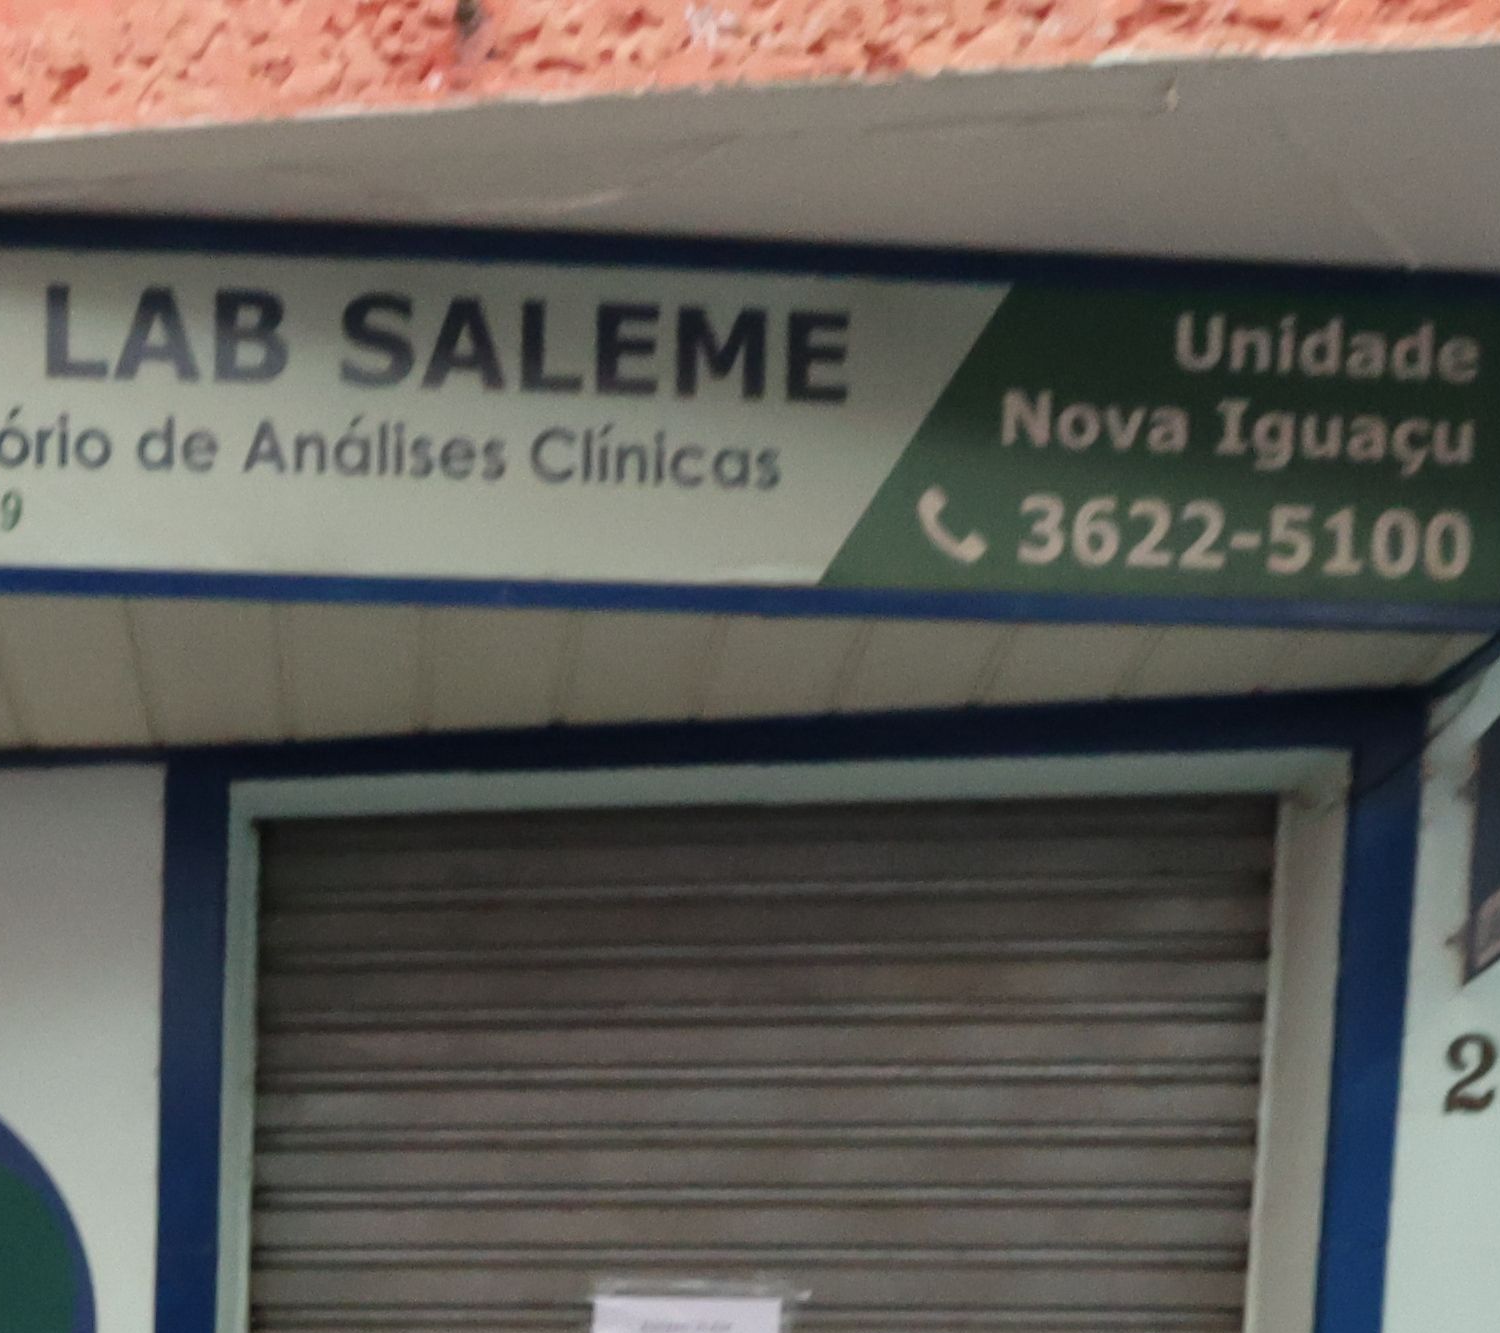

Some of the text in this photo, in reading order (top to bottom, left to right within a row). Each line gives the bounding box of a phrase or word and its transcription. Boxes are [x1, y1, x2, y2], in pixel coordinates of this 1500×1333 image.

[45, 284, 288, 383] LAB
[340, 291, 849, 403] SALEME
[1175, 311, 1480, 383] Unidade
[137, 416, 218, 472] de
[244, 414, 506, 480] Análises
[530, 423, 781, 491] Clínicas
[1001, 387, 1475, 476] Nova Iguaçu
[1017, 492, 1472, 581] 3622-5100
